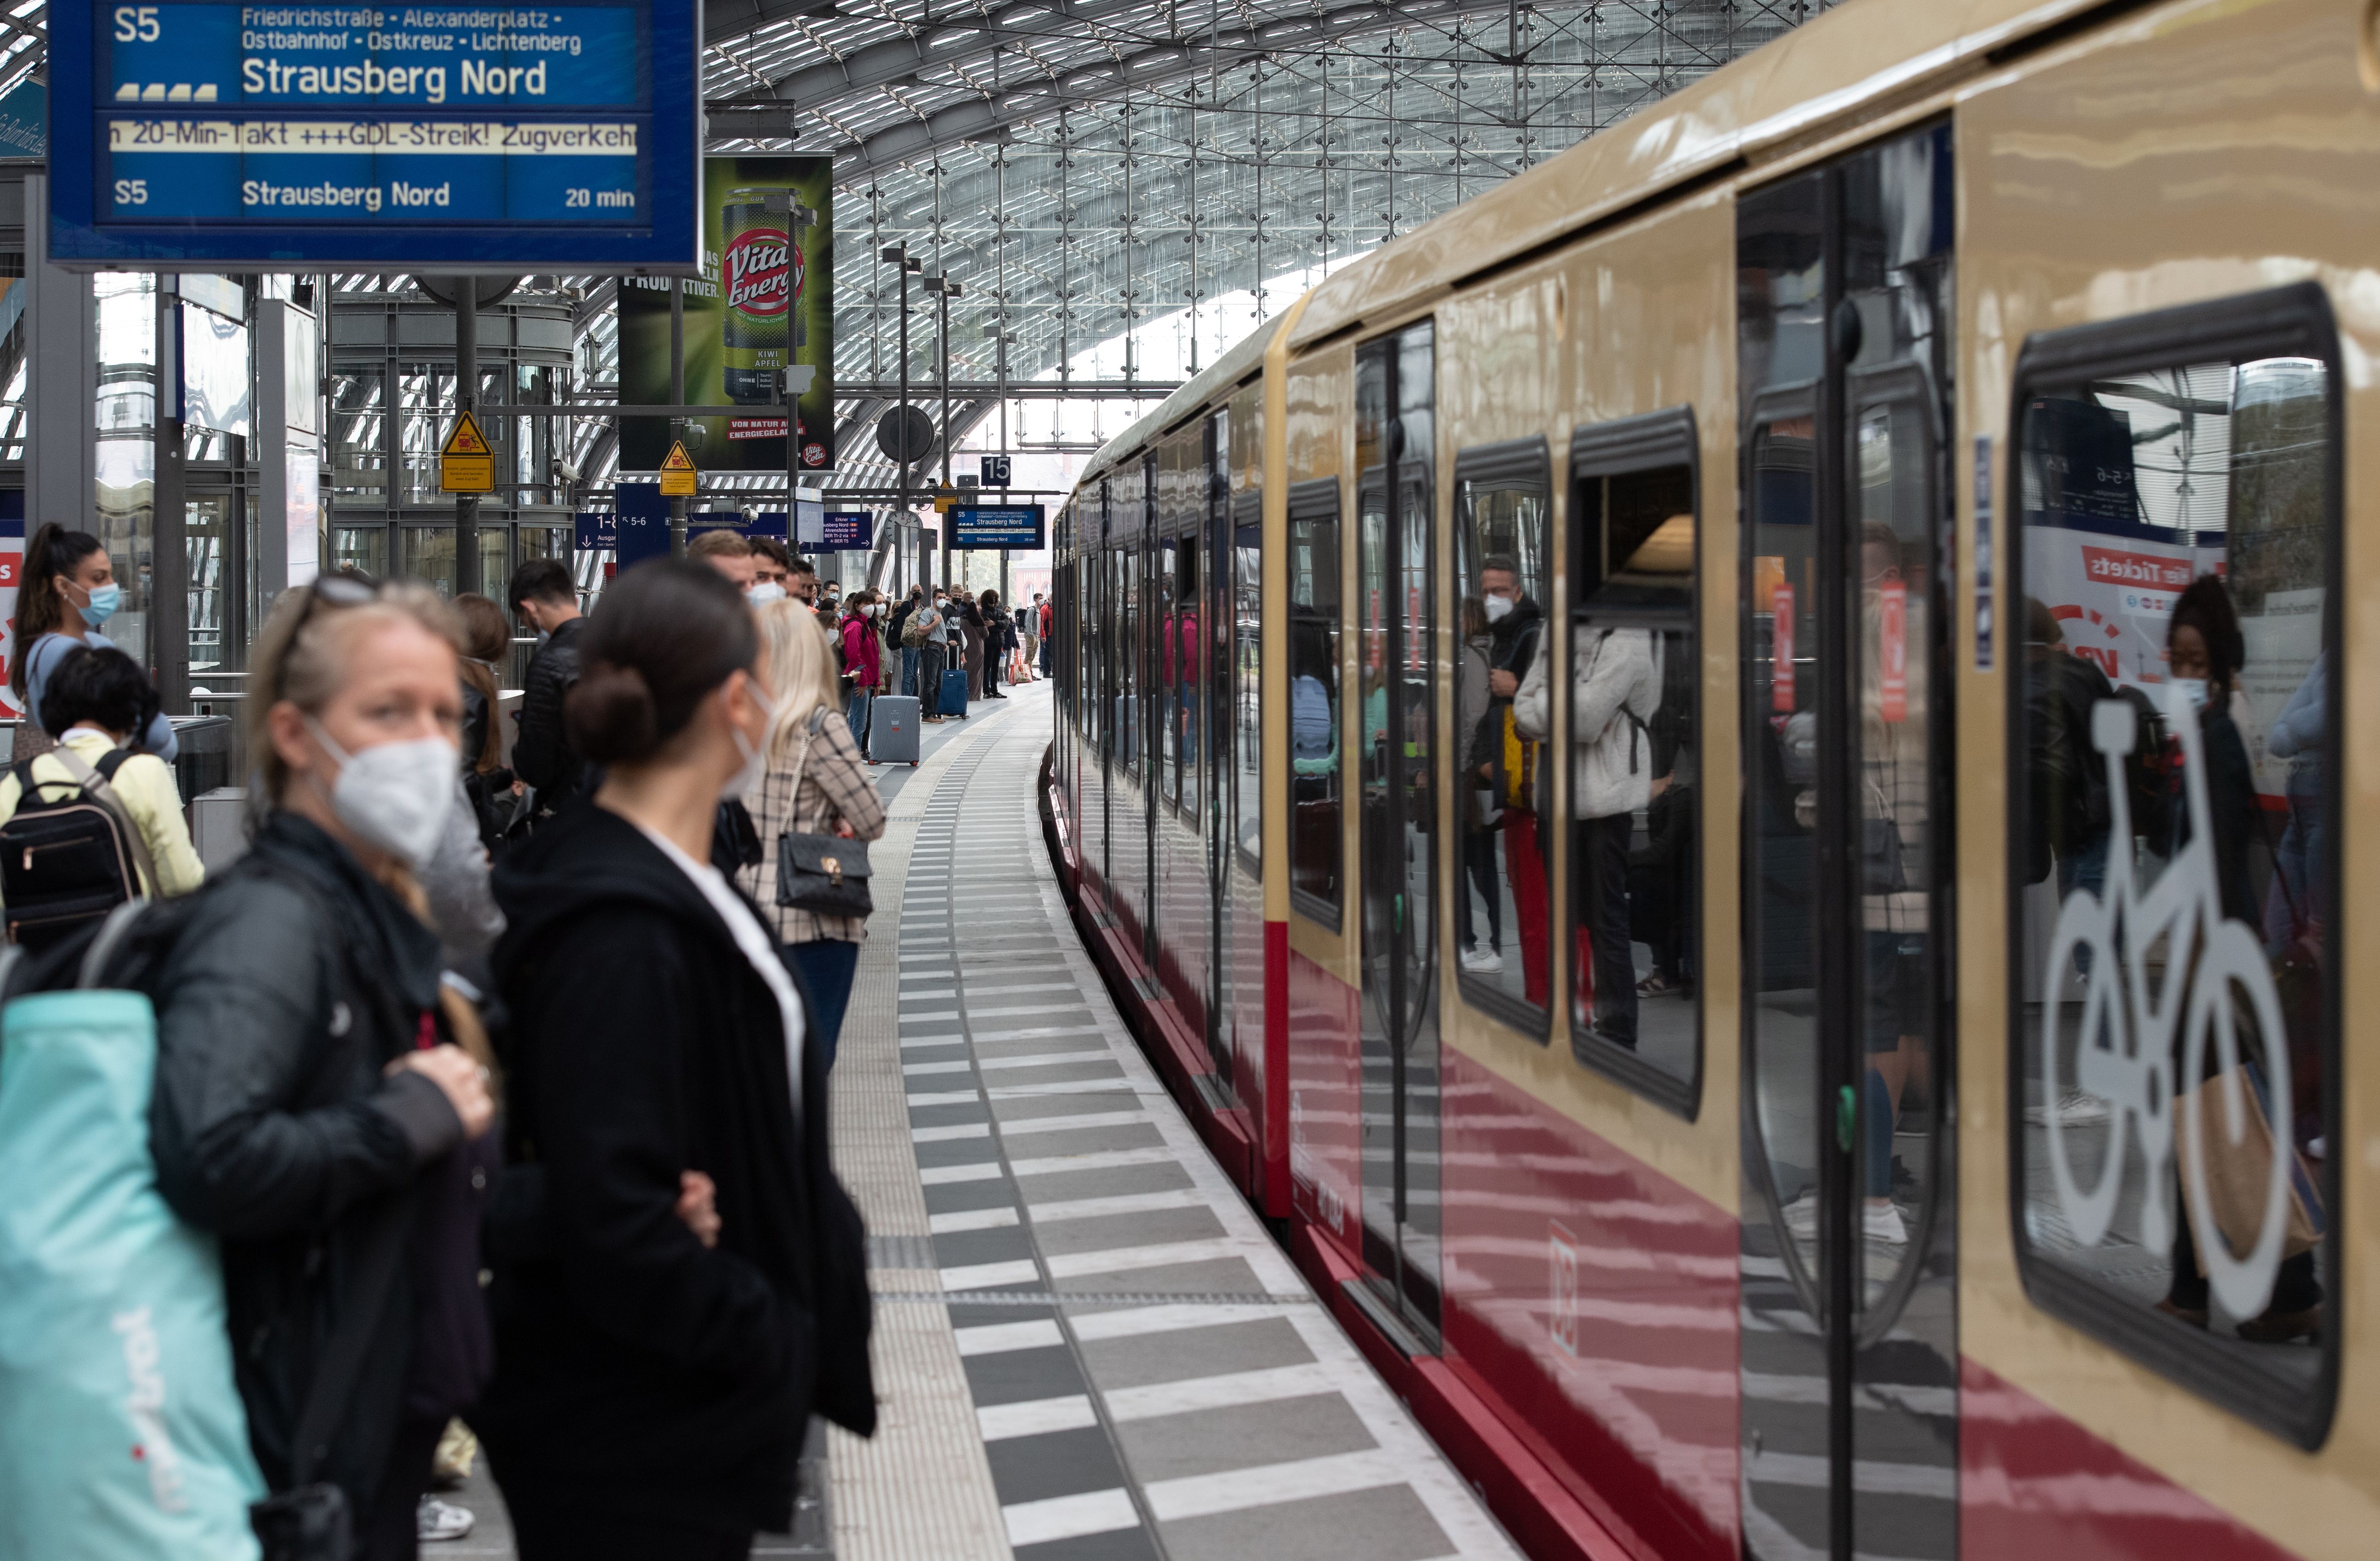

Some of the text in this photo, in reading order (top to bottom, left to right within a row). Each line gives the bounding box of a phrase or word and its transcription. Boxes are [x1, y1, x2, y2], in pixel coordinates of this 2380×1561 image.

[115, 6, 160, 42] S5
[242, 8, 384, 27] Friedrichstraße
[403, 9, 548, 31] Alexanderplatz
[242, 31, 348, 50] Ostbahnhof
[369, 33, 454, 51] Ostkreuz
[472, 33, 582, 55] Lichtenberg
[242, 58, 547, 103] Strausberg Nord
[133, 121, 288, 145] 20-Min-Takt
[115, 180, 635, 211] S5 Strausberg Nord 20 min
[725, 244, 789, 281] Vita
[703, 266, 719, 283] ELN
[728, 264, 804, 308] Energy
[624, 275, 719, 298] PRODKTIVER.
[747, 313, 787, 324] NATÜRLICHEM
[729, 428, 803, 439] ENERGIEGELADN!
[805, 446, 822, 456] Vita
[806, 452, 825, 463] Cola
[985, 457, 1010, 479] 15
[631, 517, 646, 526] 5-6
